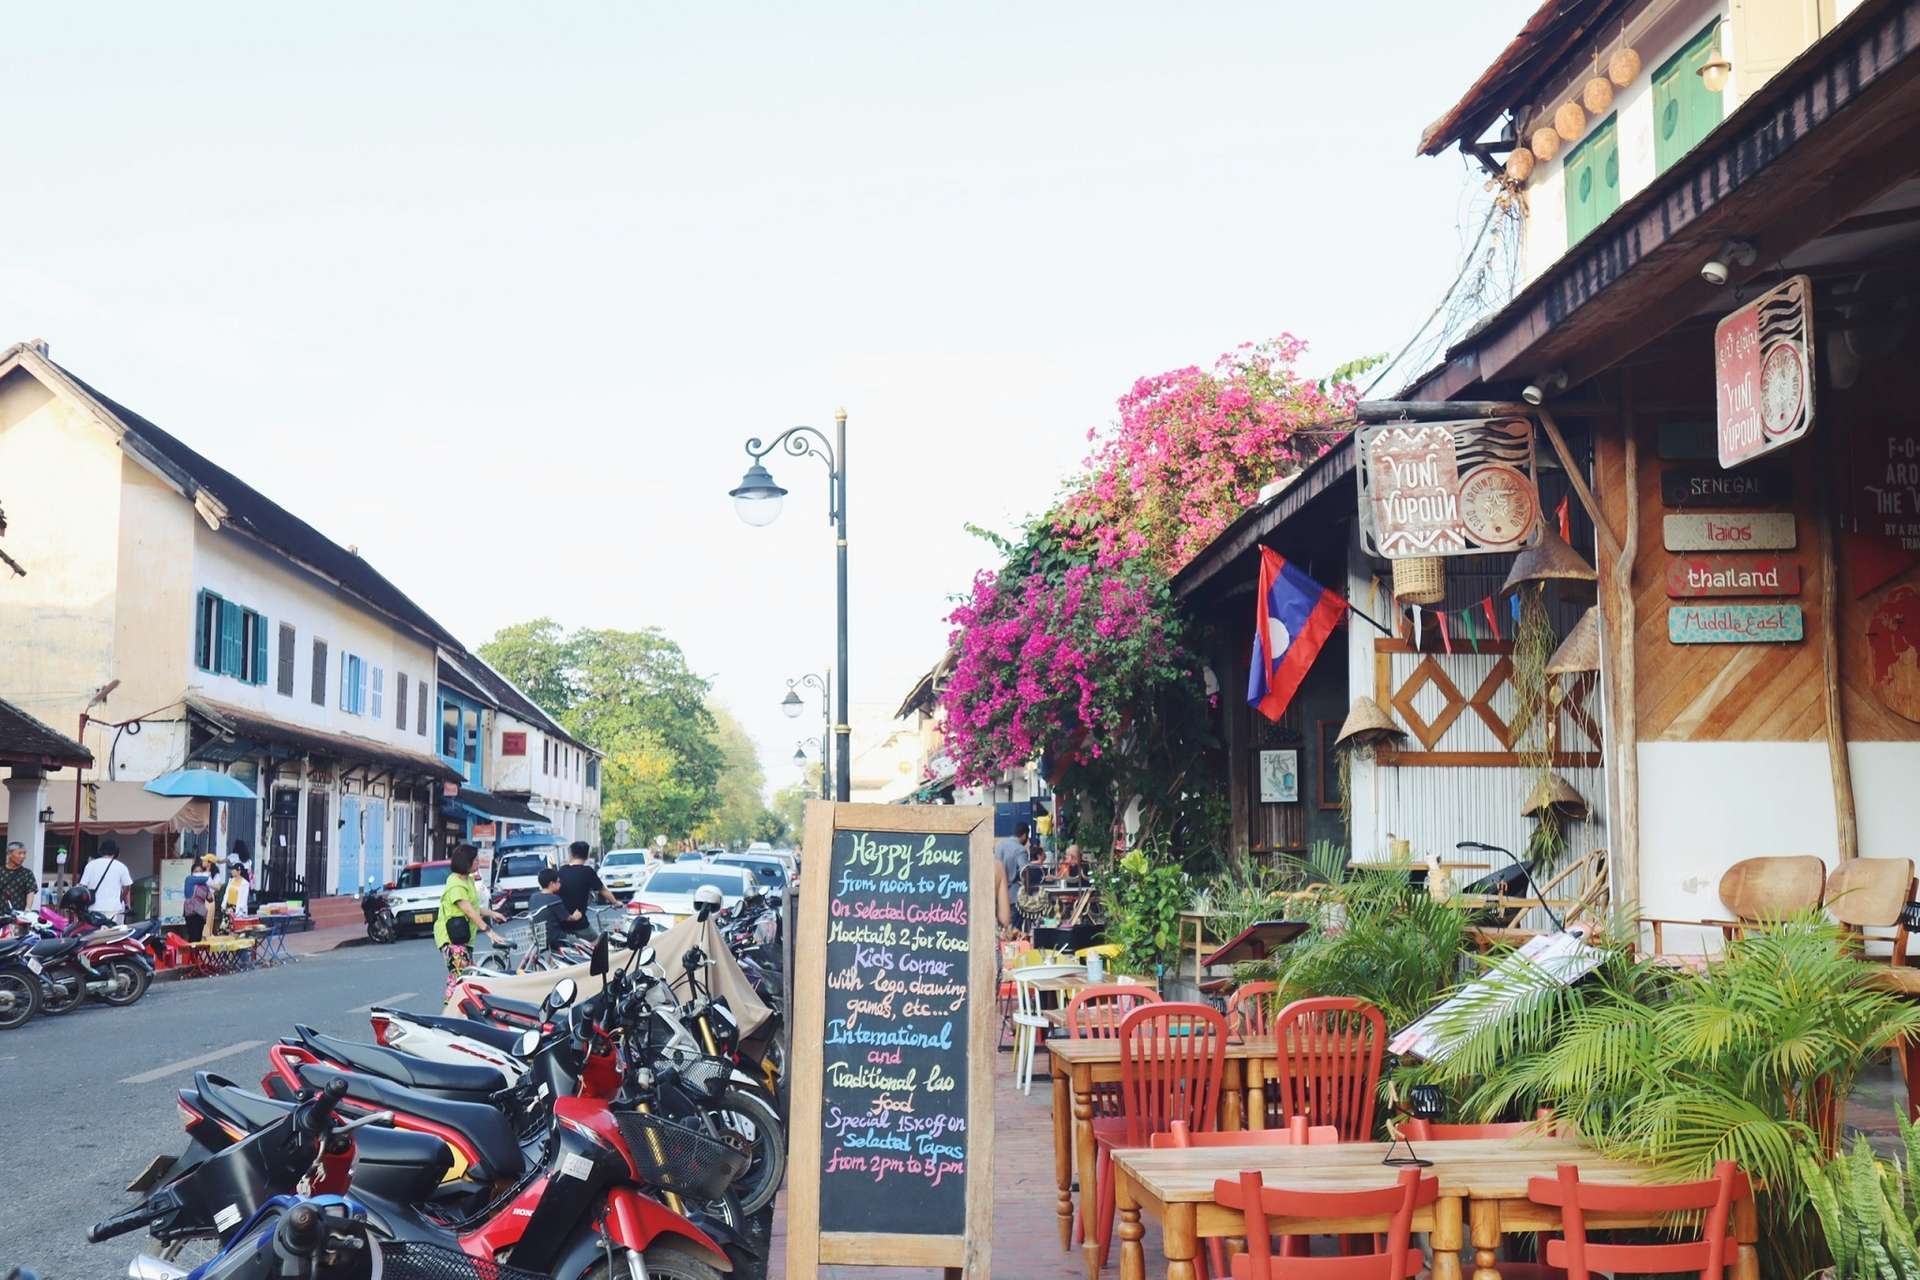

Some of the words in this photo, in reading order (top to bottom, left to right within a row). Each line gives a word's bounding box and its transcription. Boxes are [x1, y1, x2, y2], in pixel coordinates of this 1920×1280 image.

[1723, 371, 1752, 416] YUNI
[1722, 407, 1762, 455] YUPOUN
[1382, 453, 1440, 489] YUNI
[1690, 477, 1761, 497] SENEGAL
[1864, 485, 1904, 514] THE
[1382, 487, 1459, 525] YUPOUN
[1687, 567, 1780, 589] thailand
[1685, 612, 1746, 634] Middle
[1746, 612, 1787, 636] East
[845, 833, 914, 880] Happy
[915, 834, 963, 866] hour
[836, 869, 876, 897] from
[879, 881, 916, 893] noon
[918, 876, 934, 892] to
[937, 873, 968, 899] 7pm
[831, 899, 851, 917] On
[853, 899, 906, 920] Selected
[906, 898, 968, 925] Cocktails
[827, 920, 896, 947] Mocktails
[899, 927, 910, 944] 2
[911, 926, 934, 951] for
[854, 943, 894, 970] Kids
[899, 953, 955, 976] Corner
[828, 966, 864, 991] with
[909, 975, 967, 1011] drawing
[846, 999, 896, 1030] games,
[902, 999, 949, 1017] etc...
[825, 1019, 953, 1049] International
[867, 1047, 902, 1064] and
[827, 1061, 917, 1091] Traditional
[870, 1093, 914, 1116] food
[825, 1106, 891, 1136] Special
[948, 1116, 966, 1131] on
[916, 1134, 964, 1164] Tapas
[825, 1147, 867, 1173] from
[870, 1155, 905, 1182] 2pm
[906, 1155, 922, 1173] to
